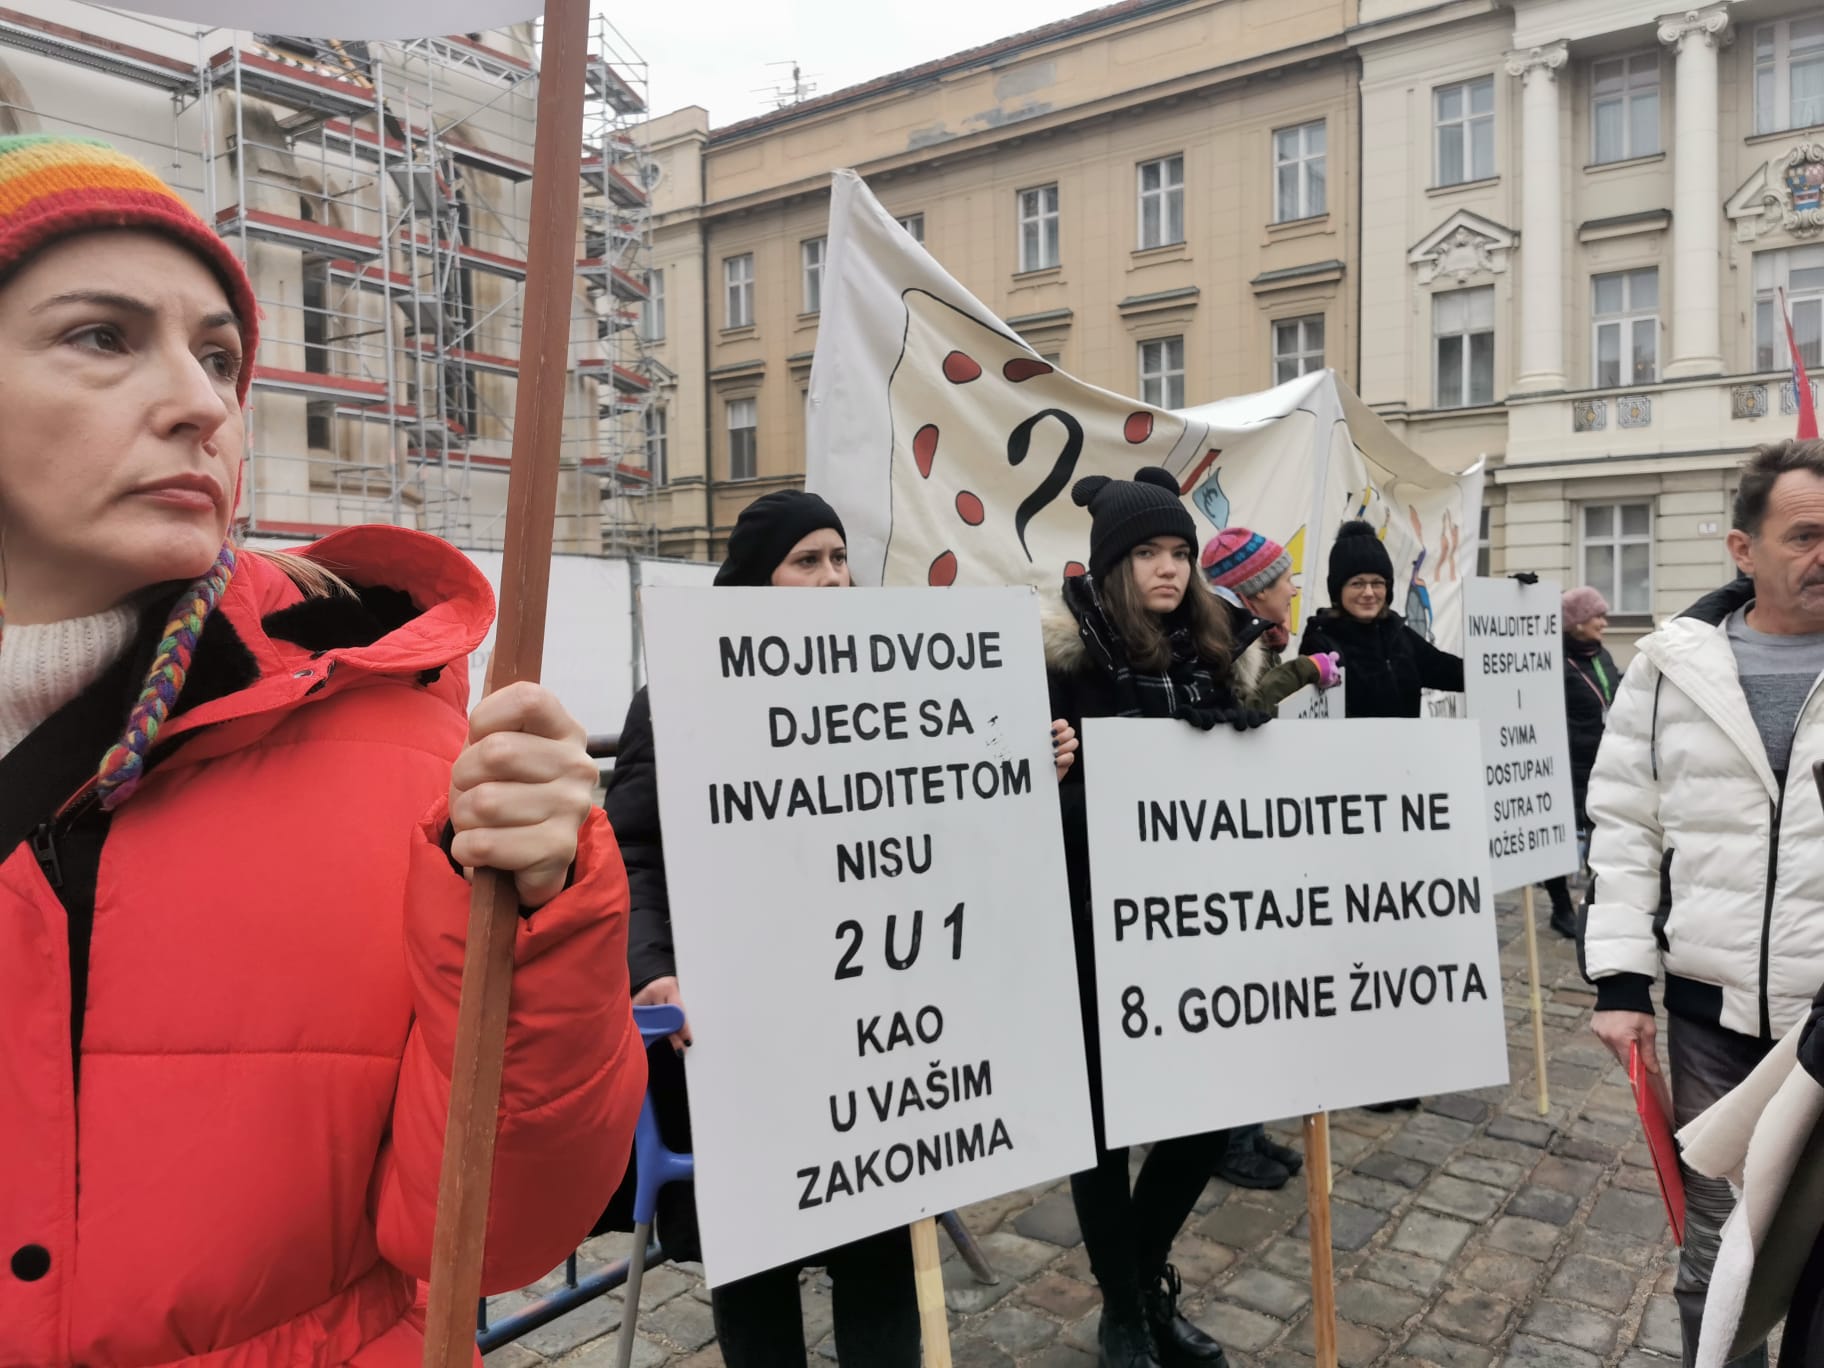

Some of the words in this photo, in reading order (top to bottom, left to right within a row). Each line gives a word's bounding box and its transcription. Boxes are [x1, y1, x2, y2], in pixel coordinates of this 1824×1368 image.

[1469, 615, 1541, 637] INVALIDITET
[1544, 614, 1557, 635] JE
[719, 634, 857, 678] MOJIH
[869, 632, 1002, 672] DVOJE
[1483, 651, 1551, 675] BESPLATAN
[769, 701, 908, 748] DJECE
[919, 698, 974, 737] SA
[1500, 724, 1537, 747] SVIMA
[709, 758, 1031, 824] INVALIDITETOM
[1486, 757, 1553, 786] DOSTUPAN!
[1138, 794, 1387, 842] INVALIDITET
[1401, 793, 1450, 832] NE
[1494, 796, 1533, 822] SUTRA
[1536, 792, 1552, 814] TO
[837, 834, 932, 883] NISU
[1528, 828, 1549, 850] BITI
[1114, 886, 1333, 942] PRESTAJE
[1345, 876, 1480, 923] NAKON
[834, 920, 863, 980] 2
[885, 910, 923, 970] U
[944, 902, 965, 960] 1
[1121, 985, 1162, 1038] 8.
[1178, 975, 1336, 1033] GODINE
[1349, 962, 1487, 1012] ŽIVOTA
[857, 1005, 943, 1057] KAO
[829, 1090, 857, 1132] U
[867, 1060, 993, 1122] VAŠIM
[797, 1118, 1014, 1210] ZAKONIMA
